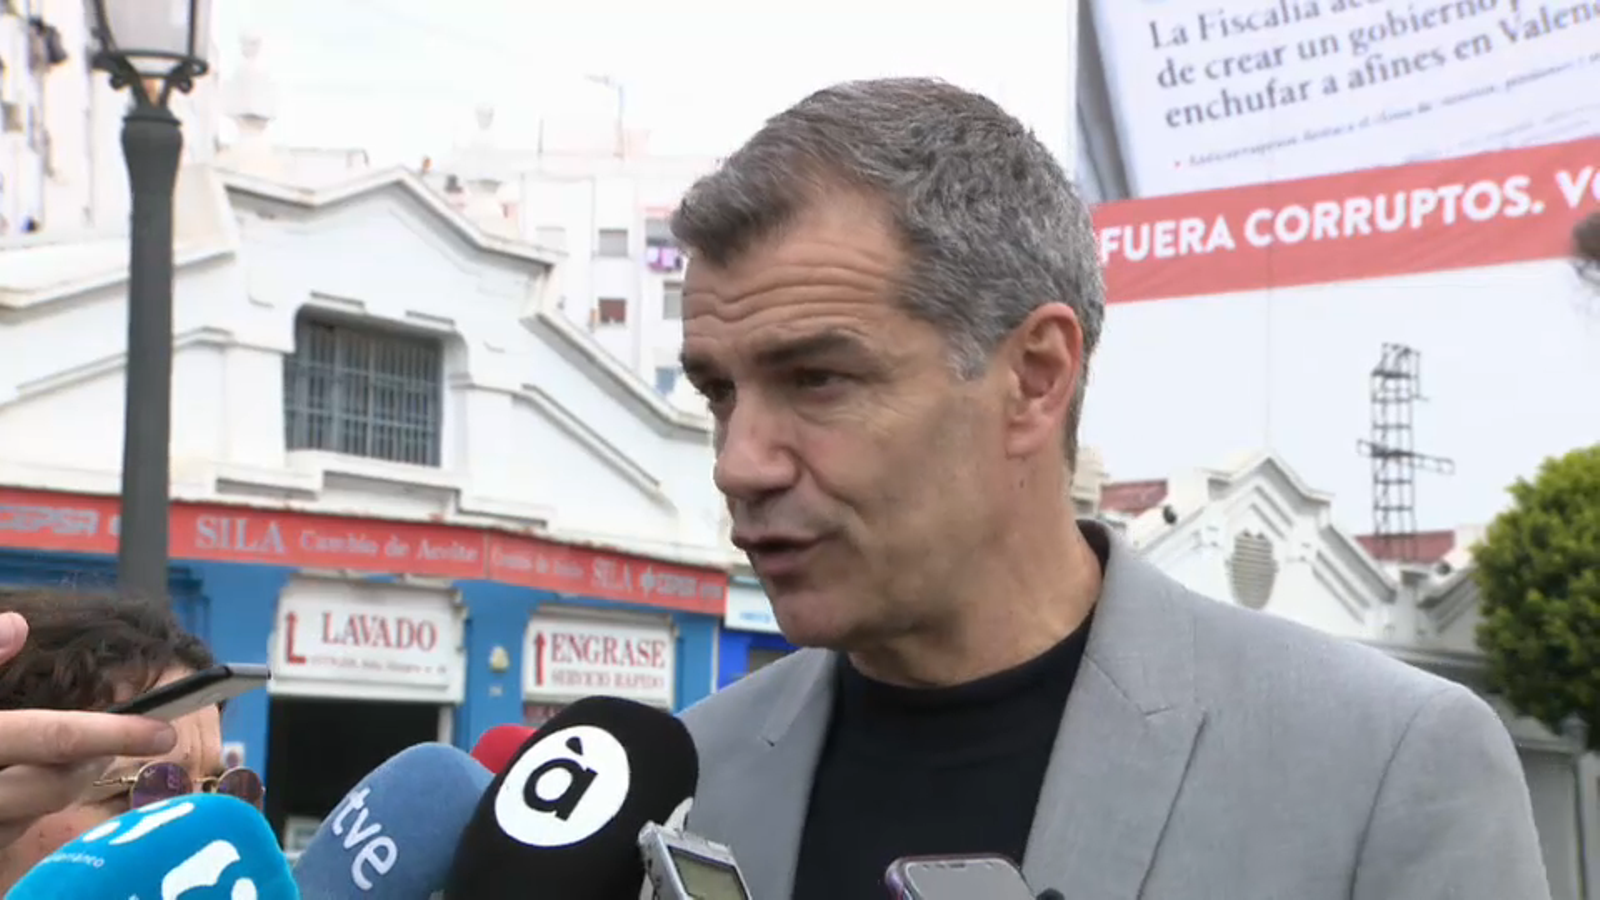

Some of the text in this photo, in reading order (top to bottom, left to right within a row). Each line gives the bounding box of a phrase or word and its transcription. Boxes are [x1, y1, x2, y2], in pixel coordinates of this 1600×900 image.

[1149, 20, 1188, 49] La
[1157, 56, 1196, 88] de
[1204, 45, 1287, 80] crear
[1297, 34, 1339, 60] un
[1348, 0, 1498, 57] gobierno
[1165, 77, 1312, 128] enchufar
[1322, 75, 1339, 95] a
[1348, 47, 1447, 90] afines
[1453, 33, 1493, 61] en
[1099, 214, 1236, 267] FUERA
[1244, 174, 1545, 248] CORRUPTOS.
[195, 514, 287, 555] SILA
[321, 611, 439, 651] LAVADO
[551, 632, 666, 669] ENGRASE
[331, 785, 398, 891] tve
